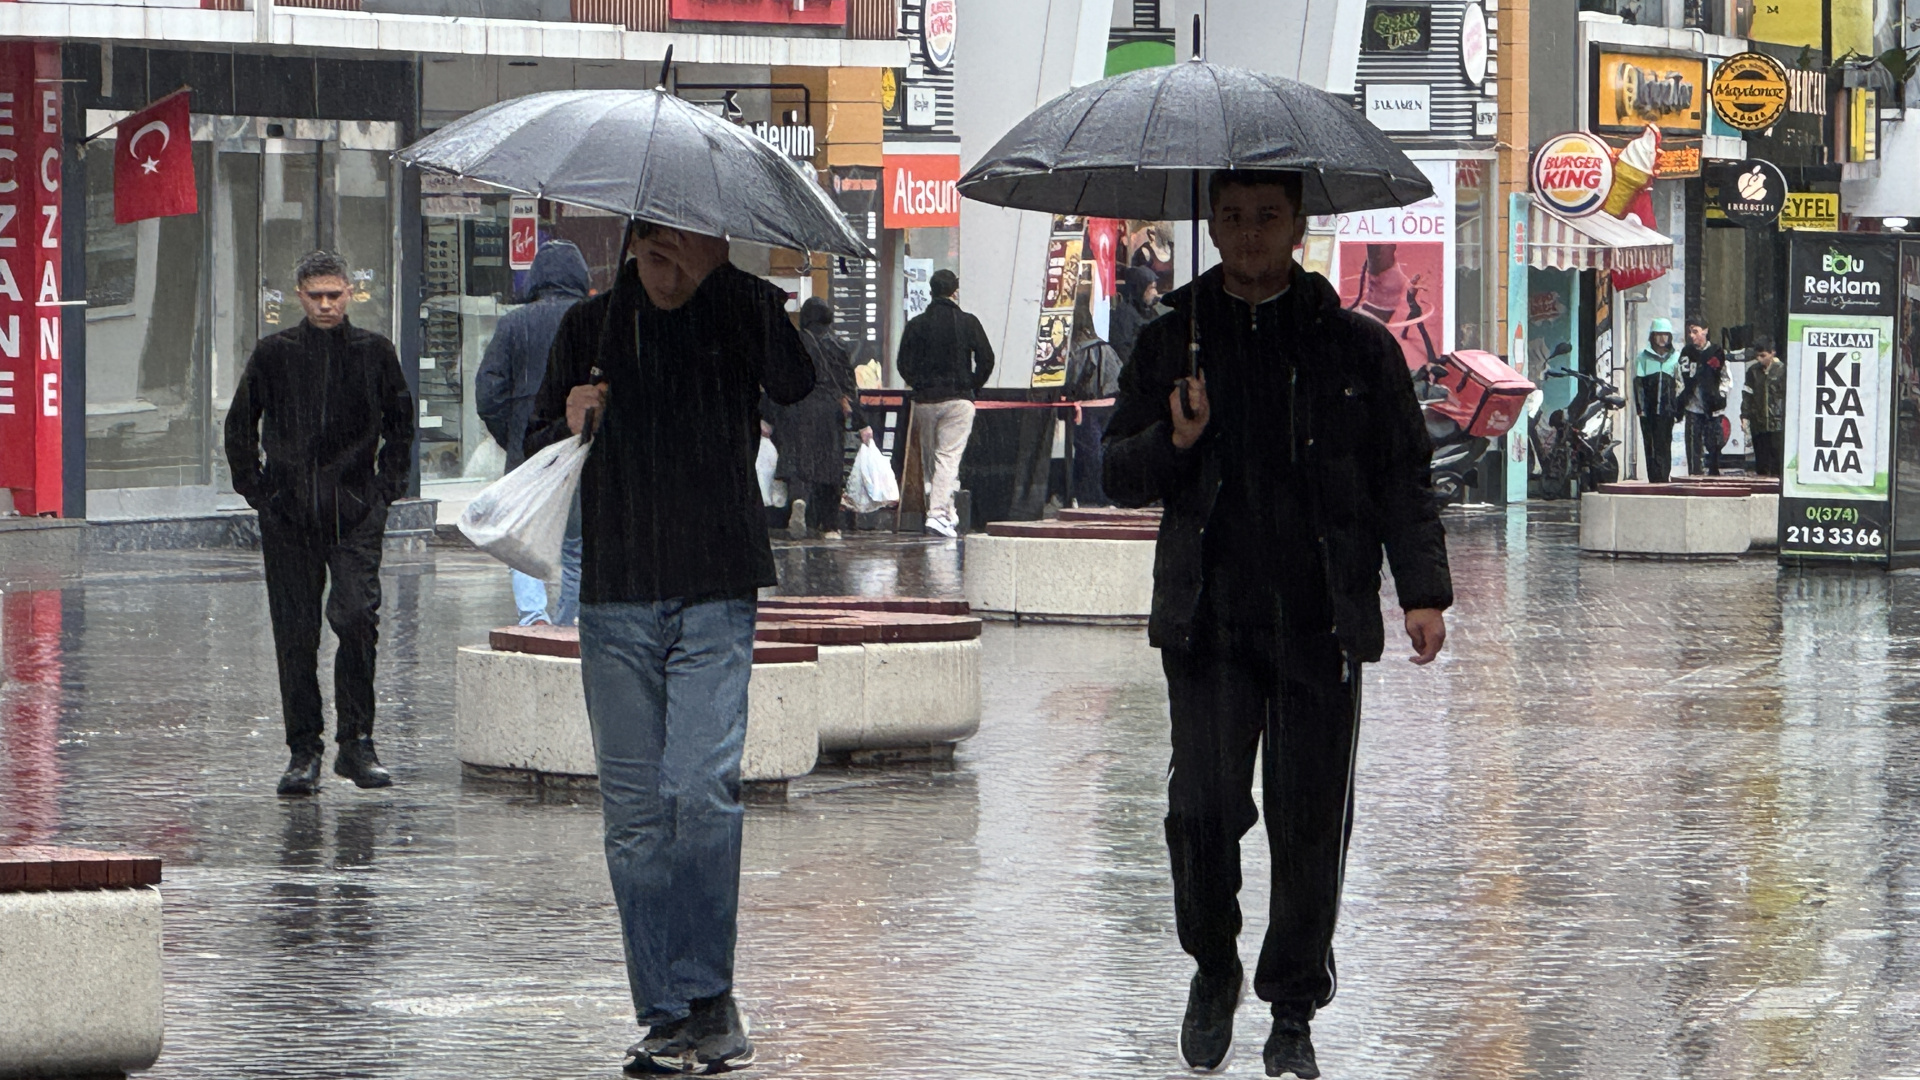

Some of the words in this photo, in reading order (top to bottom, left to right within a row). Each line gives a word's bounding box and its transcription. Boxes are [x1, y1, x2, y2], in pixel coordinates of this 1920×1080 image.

[1715, 83, 1784, 100] Maydonoz
[1544, 156, 1603, 169] BURGER
[1543, 170, 1602, 189] KING
[893, 168, 958, 214] Atasun
[1782, 197, 1835, 217] EYFEL
[1339, 215, 1350, 235] 2
[1357, 216, 1383, 235] AL
[1389, 216, 1395, 235] 1
[40, 91, 59, 416] ECZANE
[1823, 254, 1864, 275] Bolu
[1804, 276, 1880, 295] Reklam
[1809, 333, 1871, 347] REKLAM
[1815, 386, 1864, 416] RA
[1814, 417, 1863, 449] LA
[1813, 449, 1863, 474] MA
[1806, 506, 1859, 524] 0(374)
